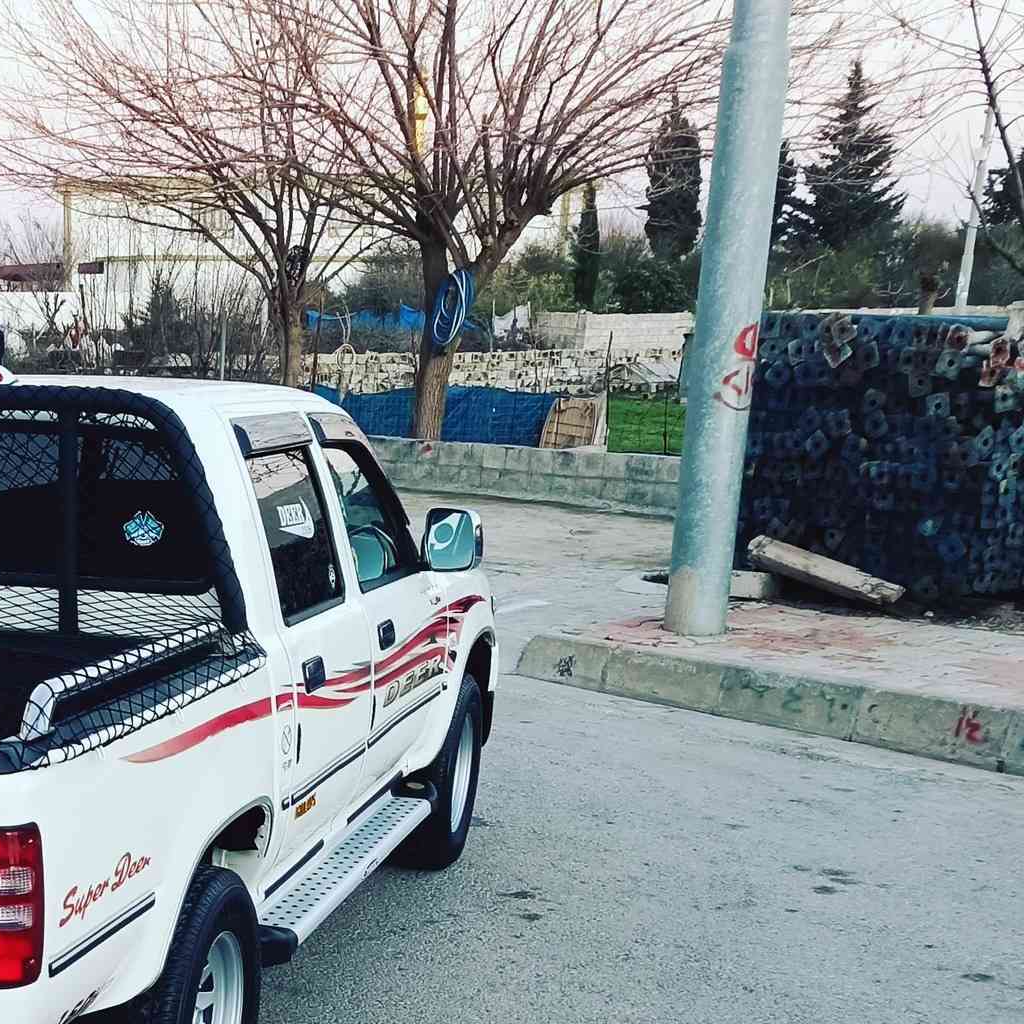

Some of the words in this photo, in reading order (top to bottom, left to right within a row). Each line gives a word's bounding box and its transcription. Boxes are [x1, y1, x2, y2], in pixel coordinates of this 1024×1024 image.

[276, 503, 305, 528] DEER
[59, 877, 111, 928] Super
[111, 852, 151, 892] Deer
